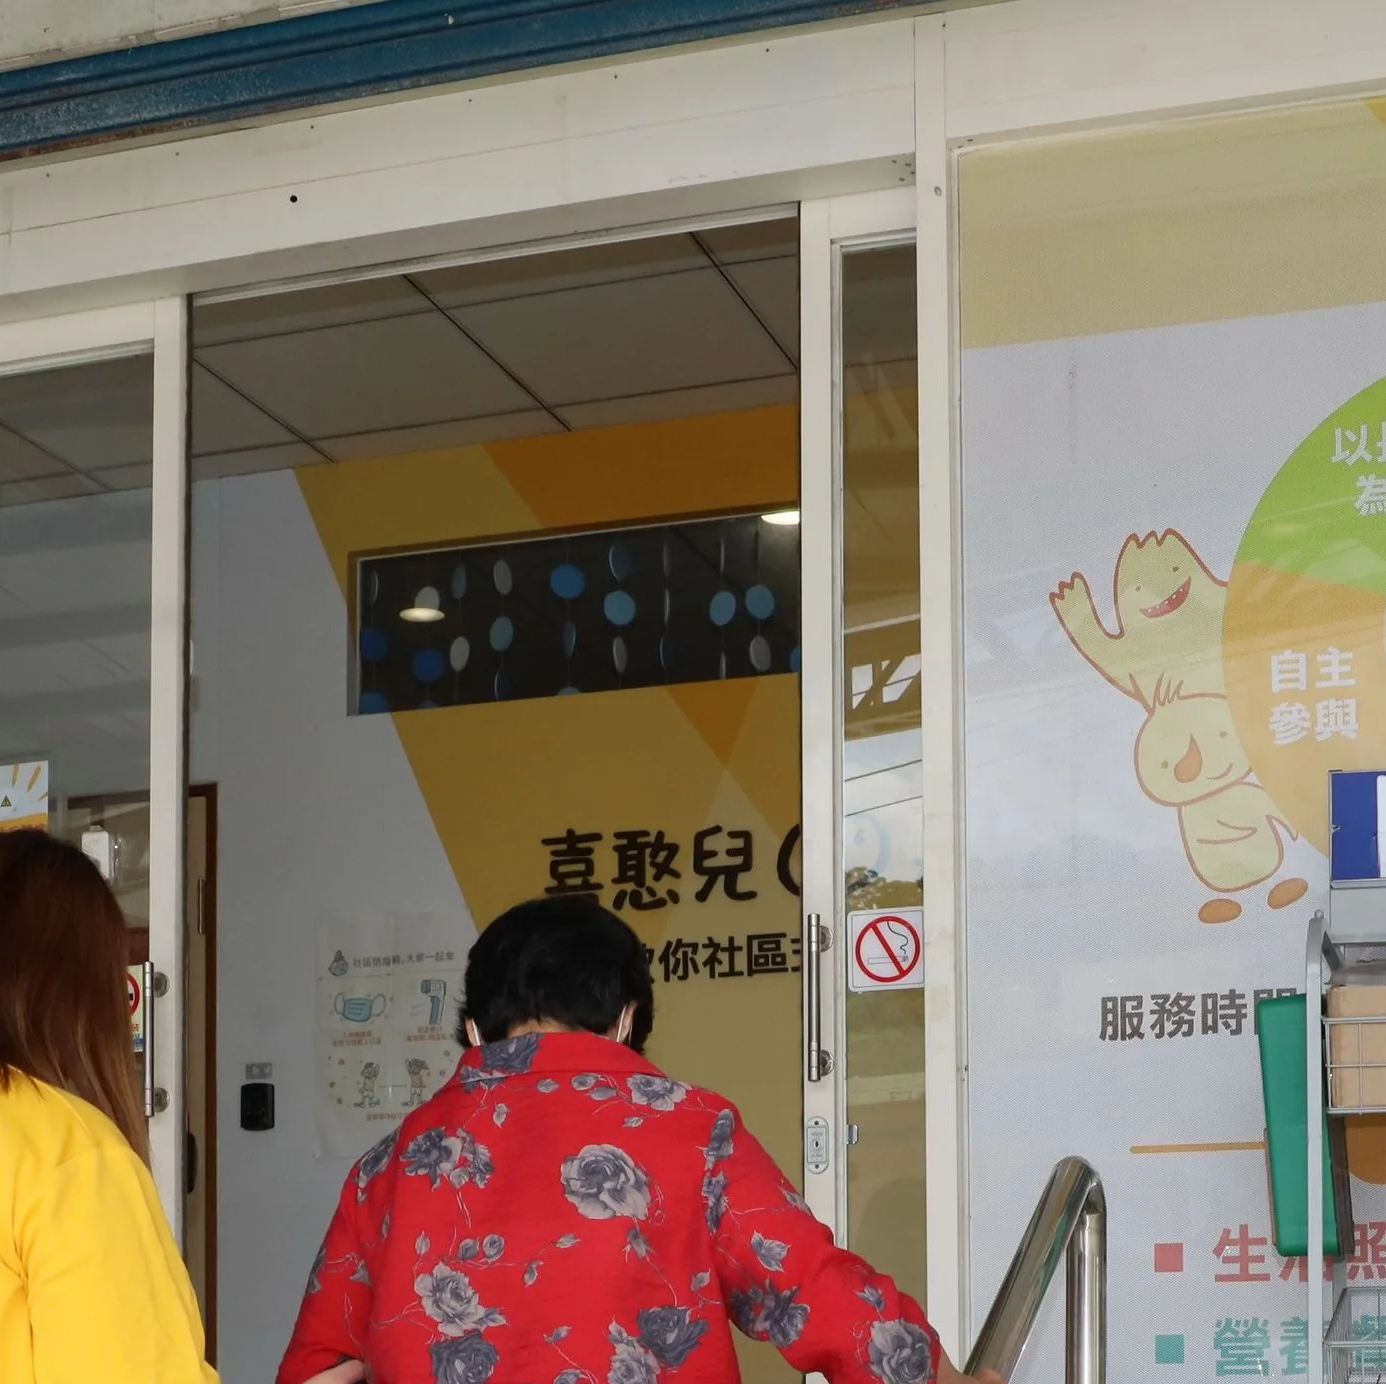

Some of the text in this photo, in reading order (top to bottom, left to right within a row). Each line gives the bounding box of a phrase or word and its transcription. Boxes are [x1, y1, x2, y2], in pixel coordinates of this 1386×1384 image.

[1270, 647, 1357, 693] 自主
[1269, 698, 1359, 746] 參與
[541, 825, 758, 912] 喜憨兒
[646, 932, 801, 986] 你社區
